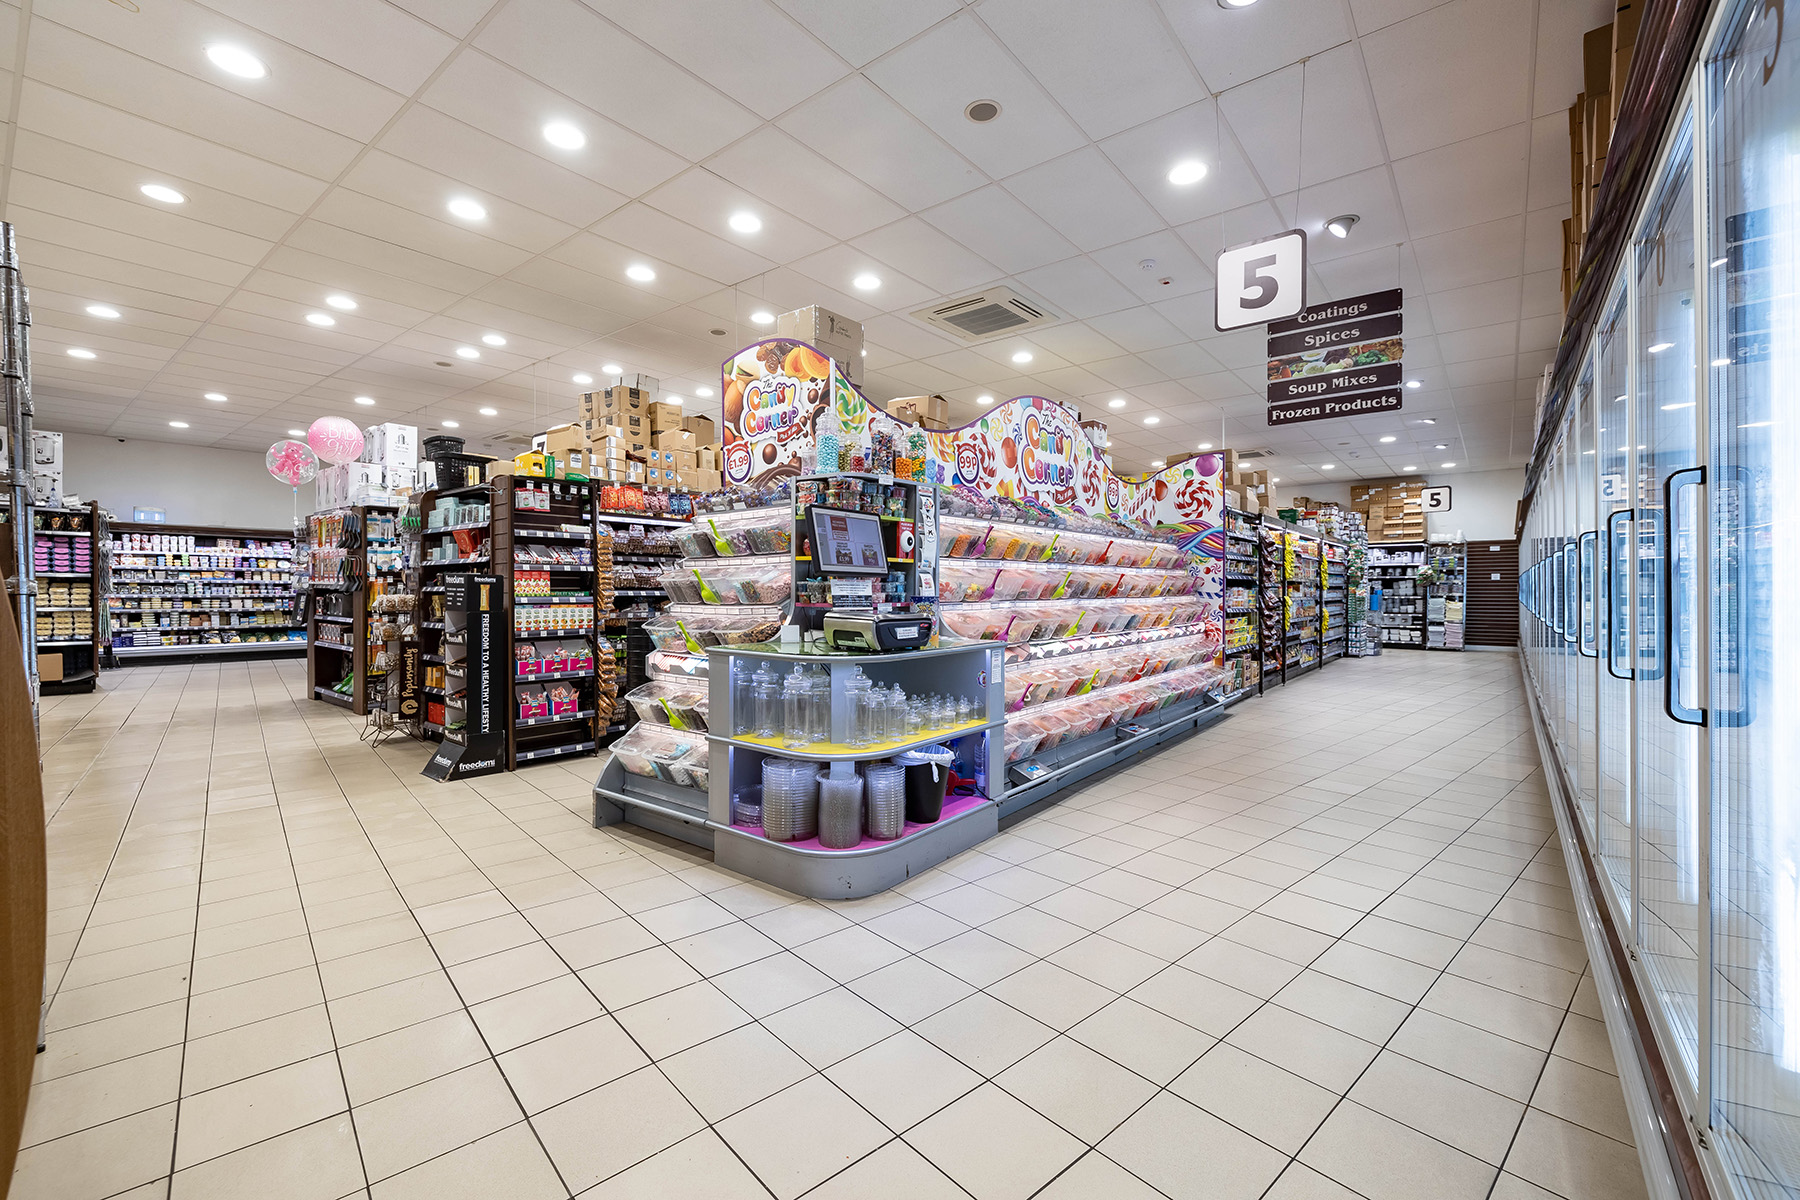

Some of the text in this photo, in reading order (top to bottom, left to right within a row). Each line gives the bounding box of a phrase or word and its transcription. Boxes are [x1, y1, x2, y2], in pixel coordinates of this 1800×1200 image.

[1239, 254, 1279, 310] 5
[1297, 301, 1368, 324] Coatings
[1304, 328, 1360, 347] Spices
[762, 379, 773, 389] The
[1288, 374, 1378, 396] Soup Mixes
[749, 385, 795, 411] Candy
[1272, 395, 1397, 420] Frozen Products
[745, 410, 797, 434] Corner
[1042, 413, 1052, 427] The
[1027, 417, 1072, 463] Candy
[728, 455, 749, 470] £1.99
[959, 455, 977, 470] 99p
[1023, 448, 1073, 486] Corner
[1428, 492, 1441, 508] 5
[482, 613, 490, 650] FREEDOM
[482, 651, 490, 661] TO
[482, 670, 490, 703] HEALTHY
